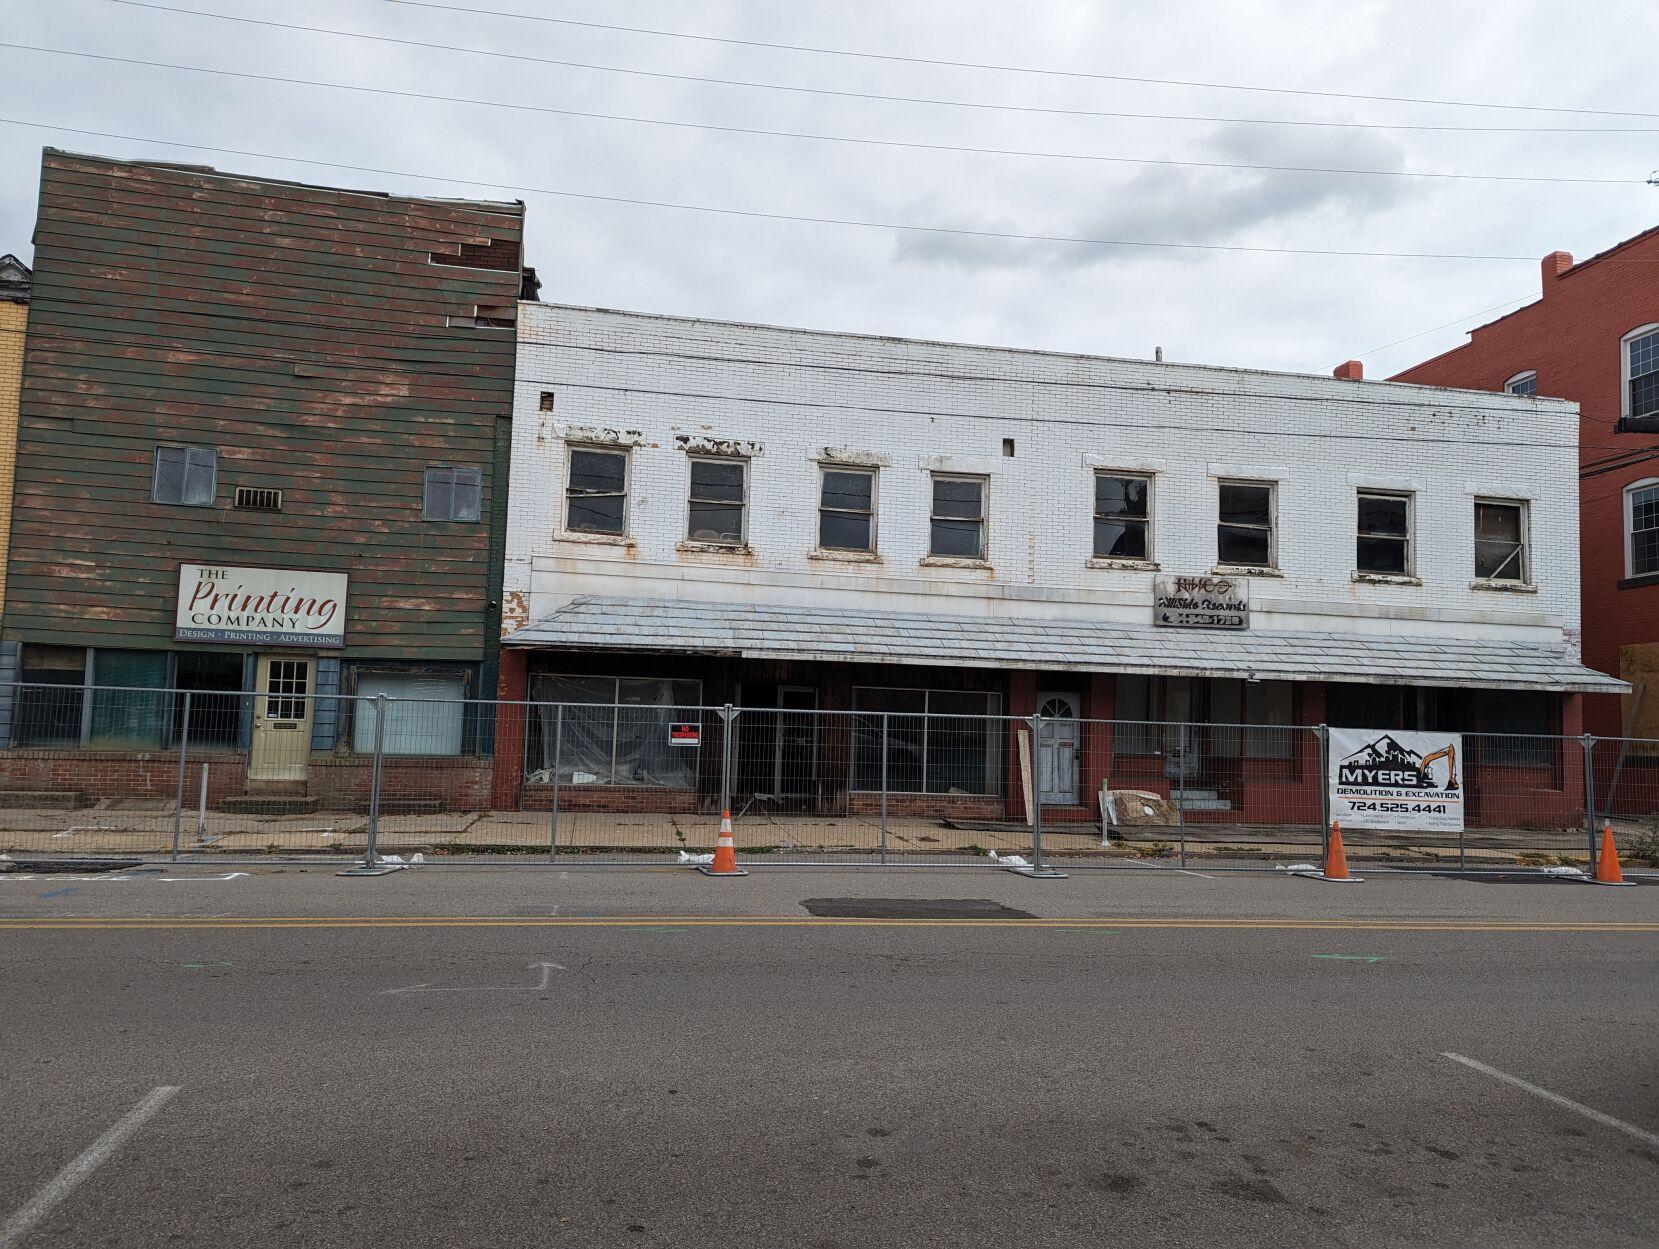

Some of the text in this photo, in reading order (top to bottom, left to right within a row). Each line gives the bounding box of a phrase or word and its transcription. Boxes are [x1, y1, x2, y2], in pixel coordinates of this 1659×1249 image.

[198, 568, 229, 580] THE
[188, 581, 338, 630] Printing
[191, 612, 300, 629] COMPANY
[1341, 768, 1418, 785] MYERS
[1336, 787, 1394, 797] DEMOLITION
[1405, 790, 1460, 800] EXCAVATION
[1348, 801, 1446, 814] 724.525.4441
